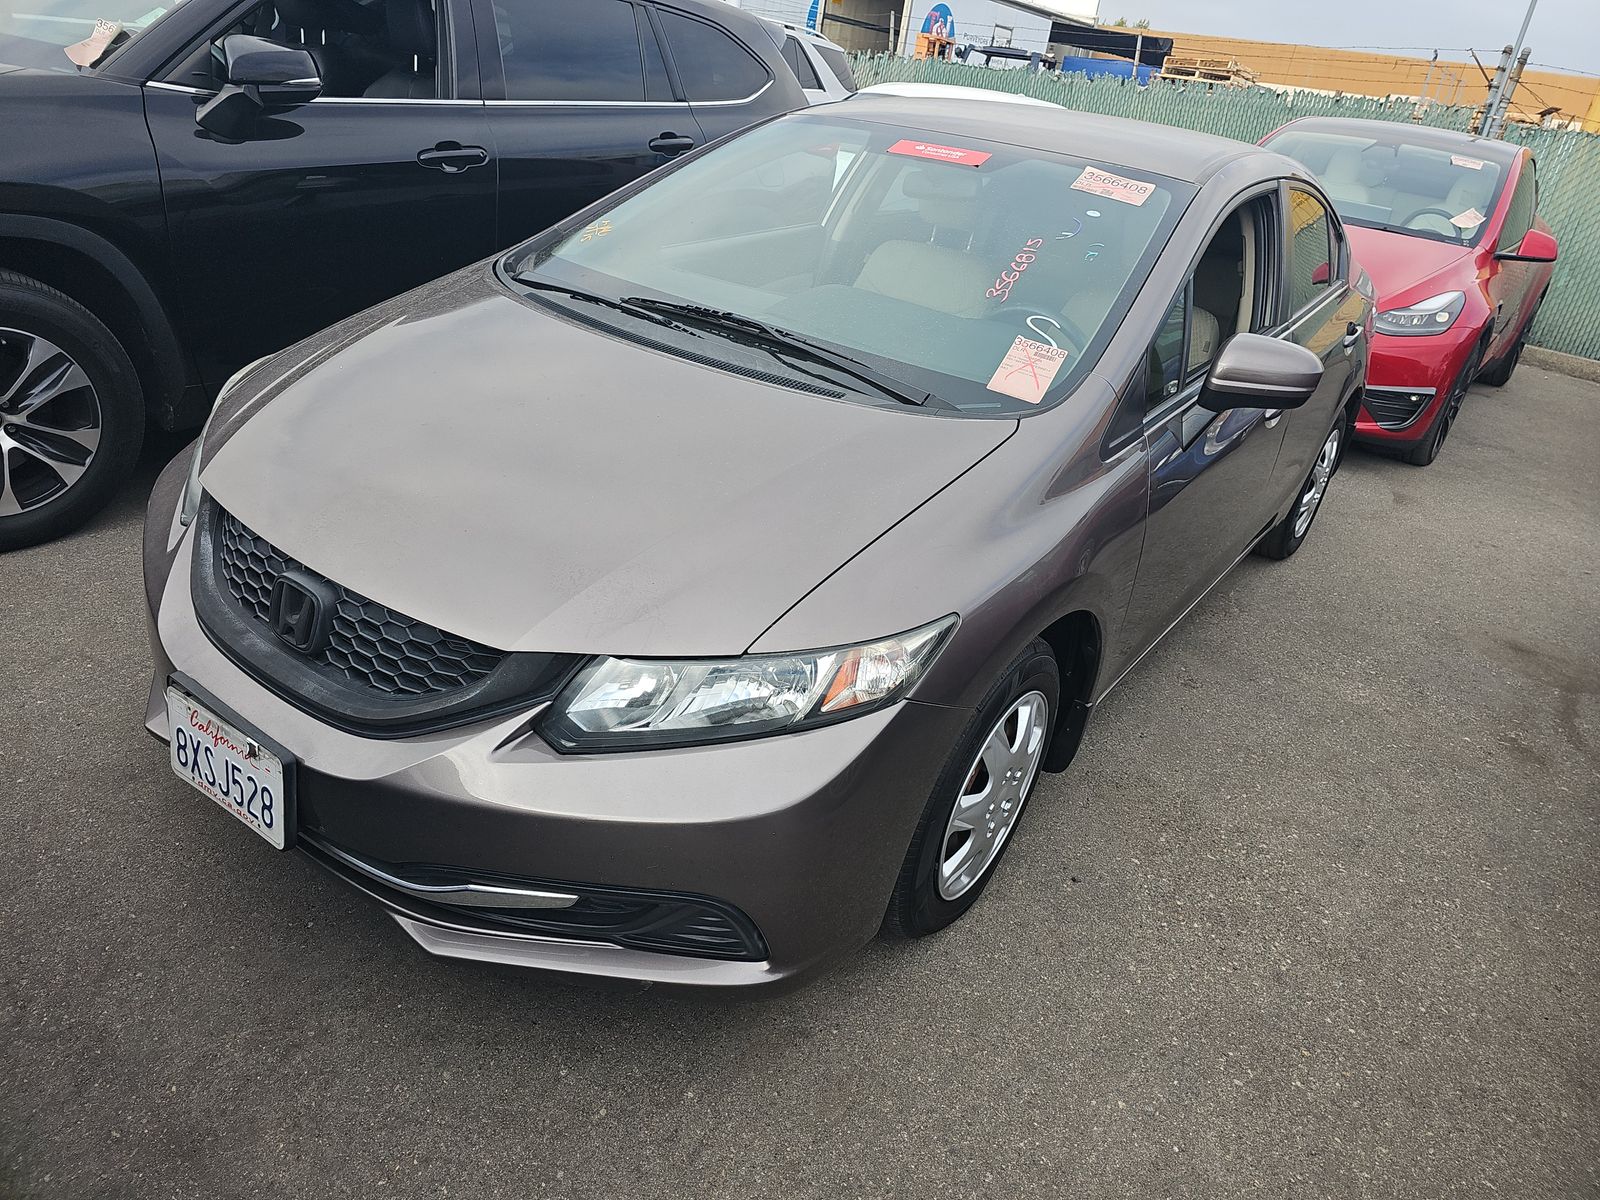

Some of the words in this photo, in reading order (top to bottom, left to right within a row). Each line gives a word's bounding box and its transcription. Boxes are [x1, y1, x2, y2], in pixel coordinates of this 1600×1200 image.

[1083, 171, 1149, 195] 3566408
[1014, 336, 1066, 360] 3566408
[176, 727, 273, 829] 8XSJ528
